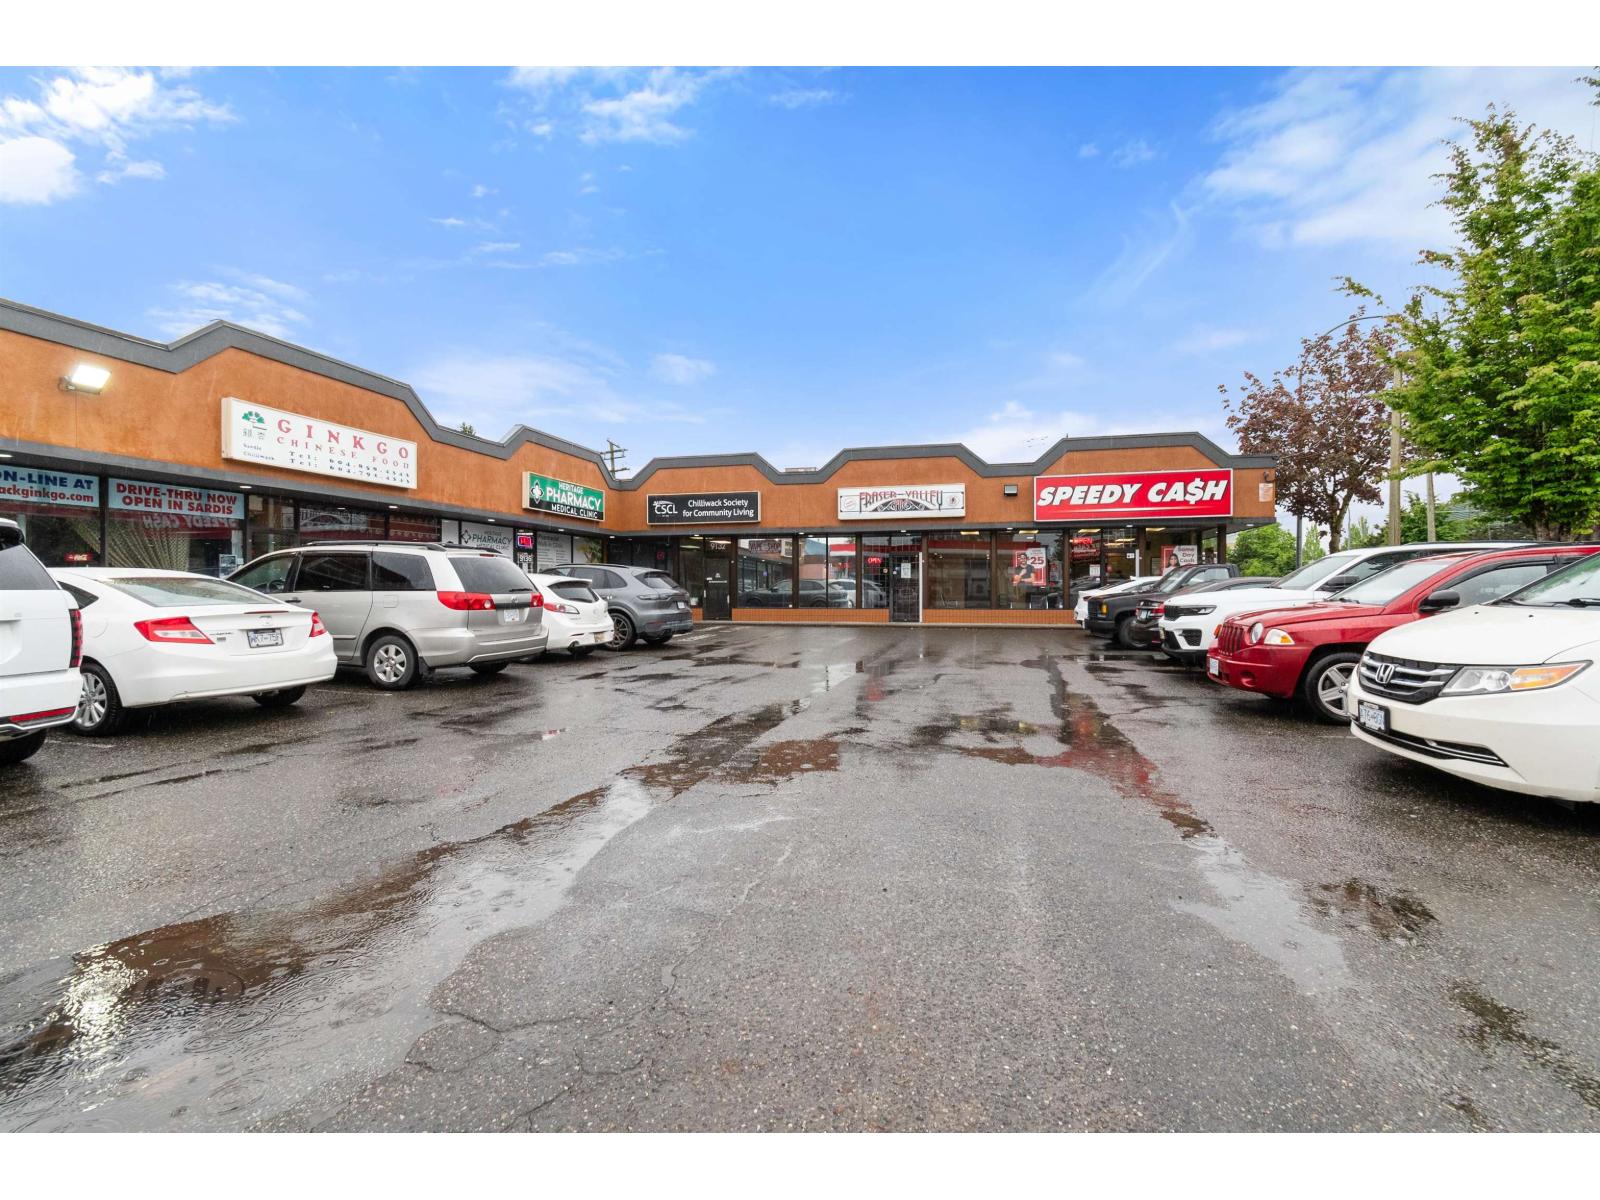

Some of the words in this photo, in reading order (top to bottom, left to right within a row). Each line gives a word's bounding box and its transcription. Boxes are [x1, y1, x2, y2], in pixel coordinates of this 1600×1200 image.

[277, 419, 409, 459] GINKGO
[277, 436, 357, 459] CHINESE
[372, 456, 409, 470] FOOD
[0, 484, 94, 503] ackginkgo.com
[73, 479, 94, 490] AT
[116, 482, 203, 501] DRIVE-THRU
[207, 493, 237, 505] NOW
[558, 482, 584, 495] HERITAGE
[1037, 483, 1143, 507] SPEEDY
[1147, 477, 1228, 504] CA$H
[122, 495, 162, 508] OPEN
[168, 500, 183, 510] IN
[188, 502, 233, 515] SARDIS
[546, 487, 602, 511] PHARMACY
[688, 499, 722, 507] Chilliwack
[723, 498, 748, 507] Society
[860, 491, 897, 513] FRASER
[905, 490, 943, 511] VALLEY
[551, 503, 578, 516] MEDICAL
[580, 509, 598, 519] CLINIC
[654, 504, 678, 514] CSCL
[682, 509, 692, 517] for
[693, 508, 732, 517] Community
[733, 507, 754, 517] Living
[472, 534, 512, 546] PHARMACY
